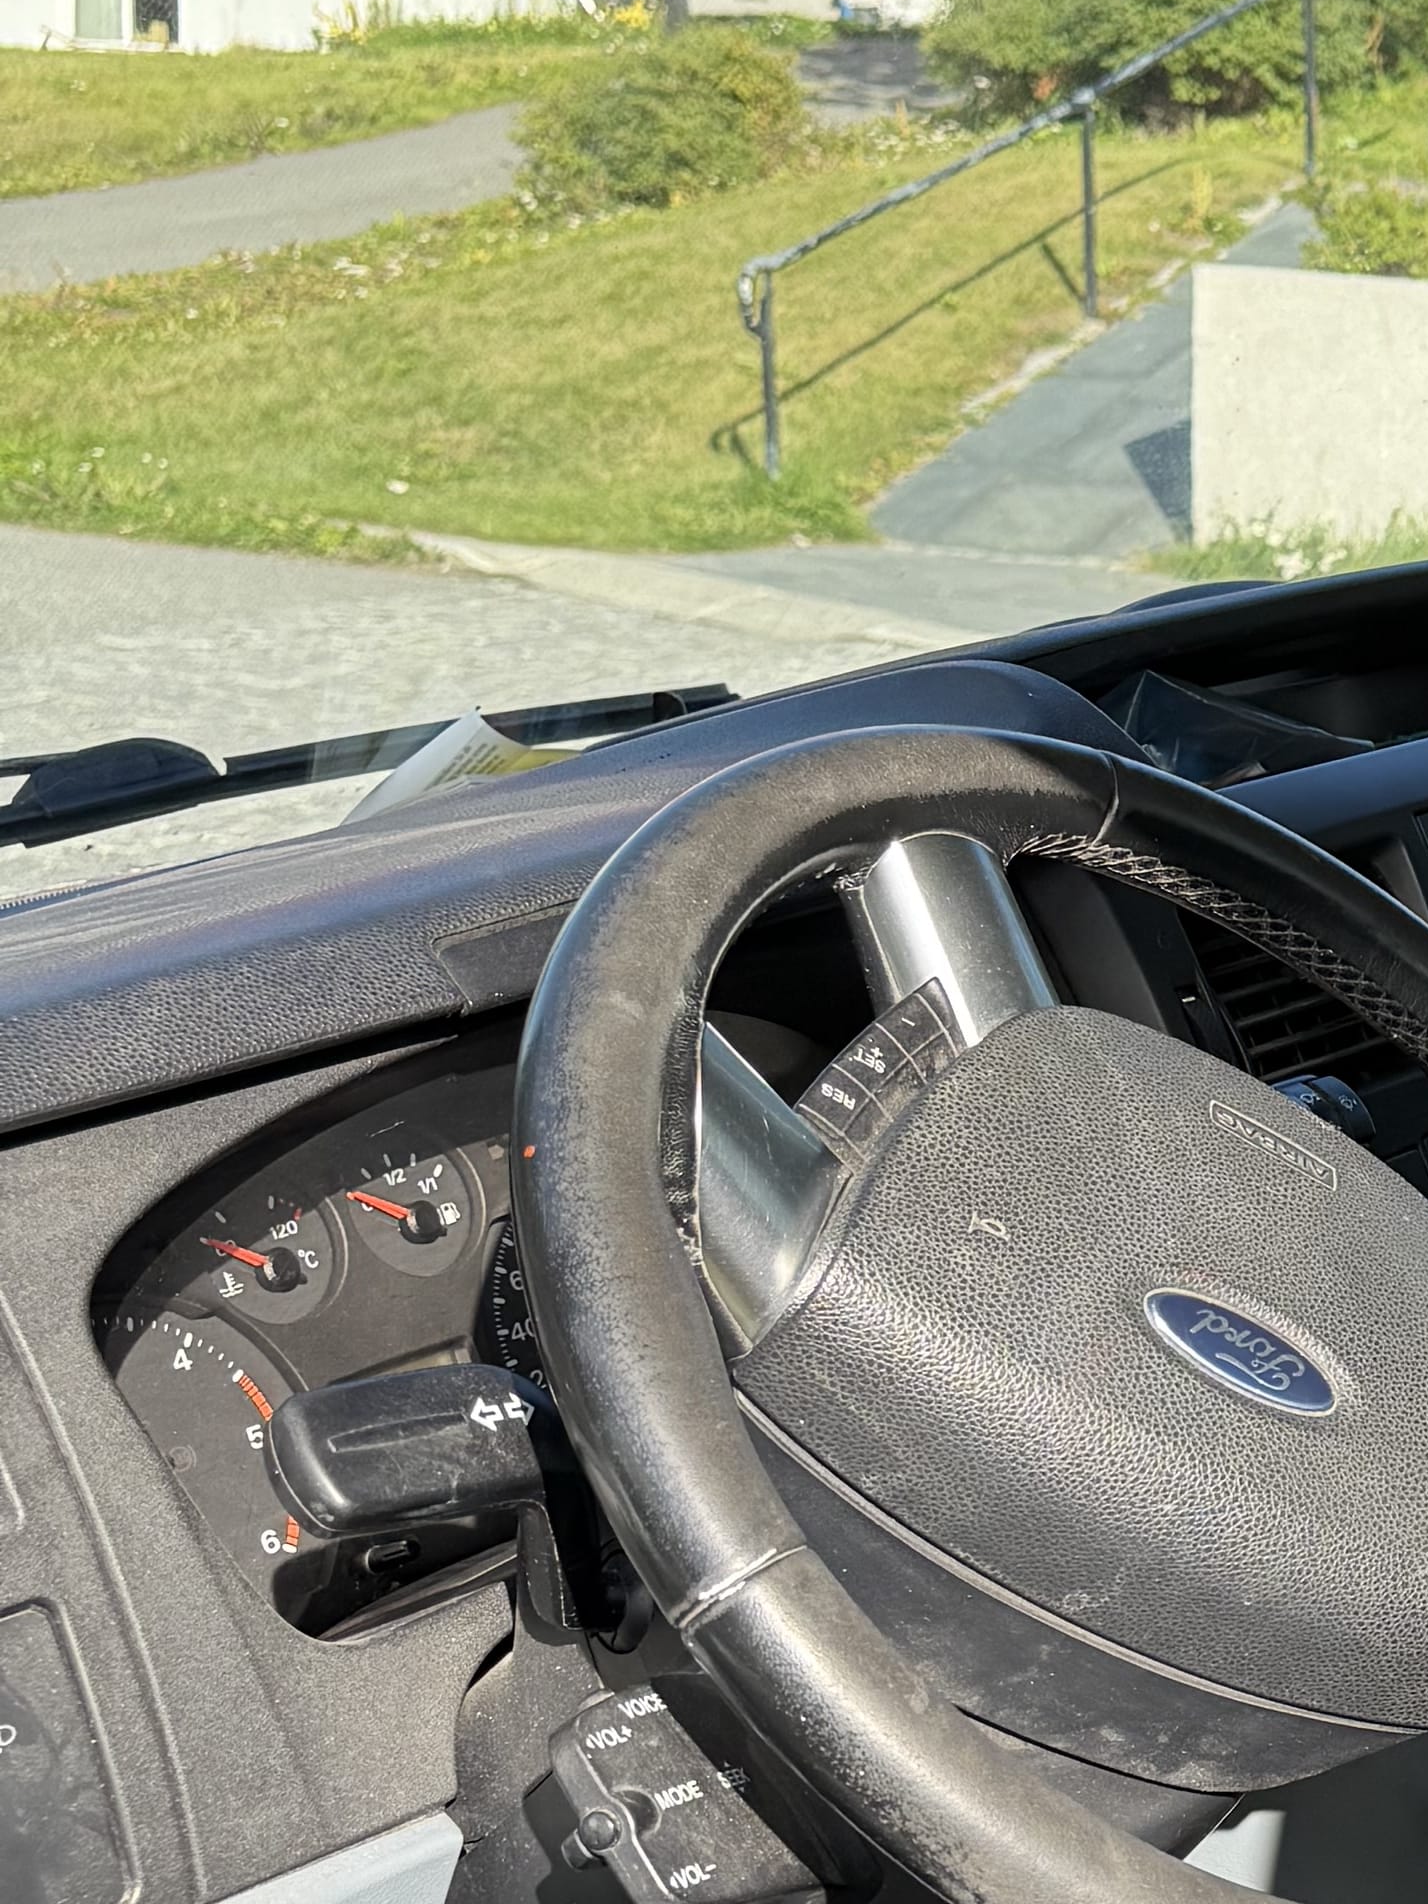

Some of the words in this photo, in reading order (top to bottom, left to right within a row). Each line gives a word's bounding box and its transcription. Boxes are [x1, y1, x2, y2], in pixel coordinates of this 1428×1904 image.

[854, 1047, 887, 1074] SET
[820, 1082, 856, 1111] RES
[1215, 1110, 1328, 1179] AIRBAG
[383, 1167, 407, 1187] 1/2
[417, 1176, 438, 1195] 1/1
[269, 1219, 298, 1241] 120
[509, 1270, 524, 1291] 6
[171, 1348, 193, 1373] 4
[1190, 1308, 1305, 1393] Ford
[245, 1424, 264, 1452] 5
[260, 1528, 281, 1555] 6
[619, 1692, 668, 1720] VOICE
[716, 1767, 751, 1789] SEEK
[655, 1780, 703, 1811] MODE
